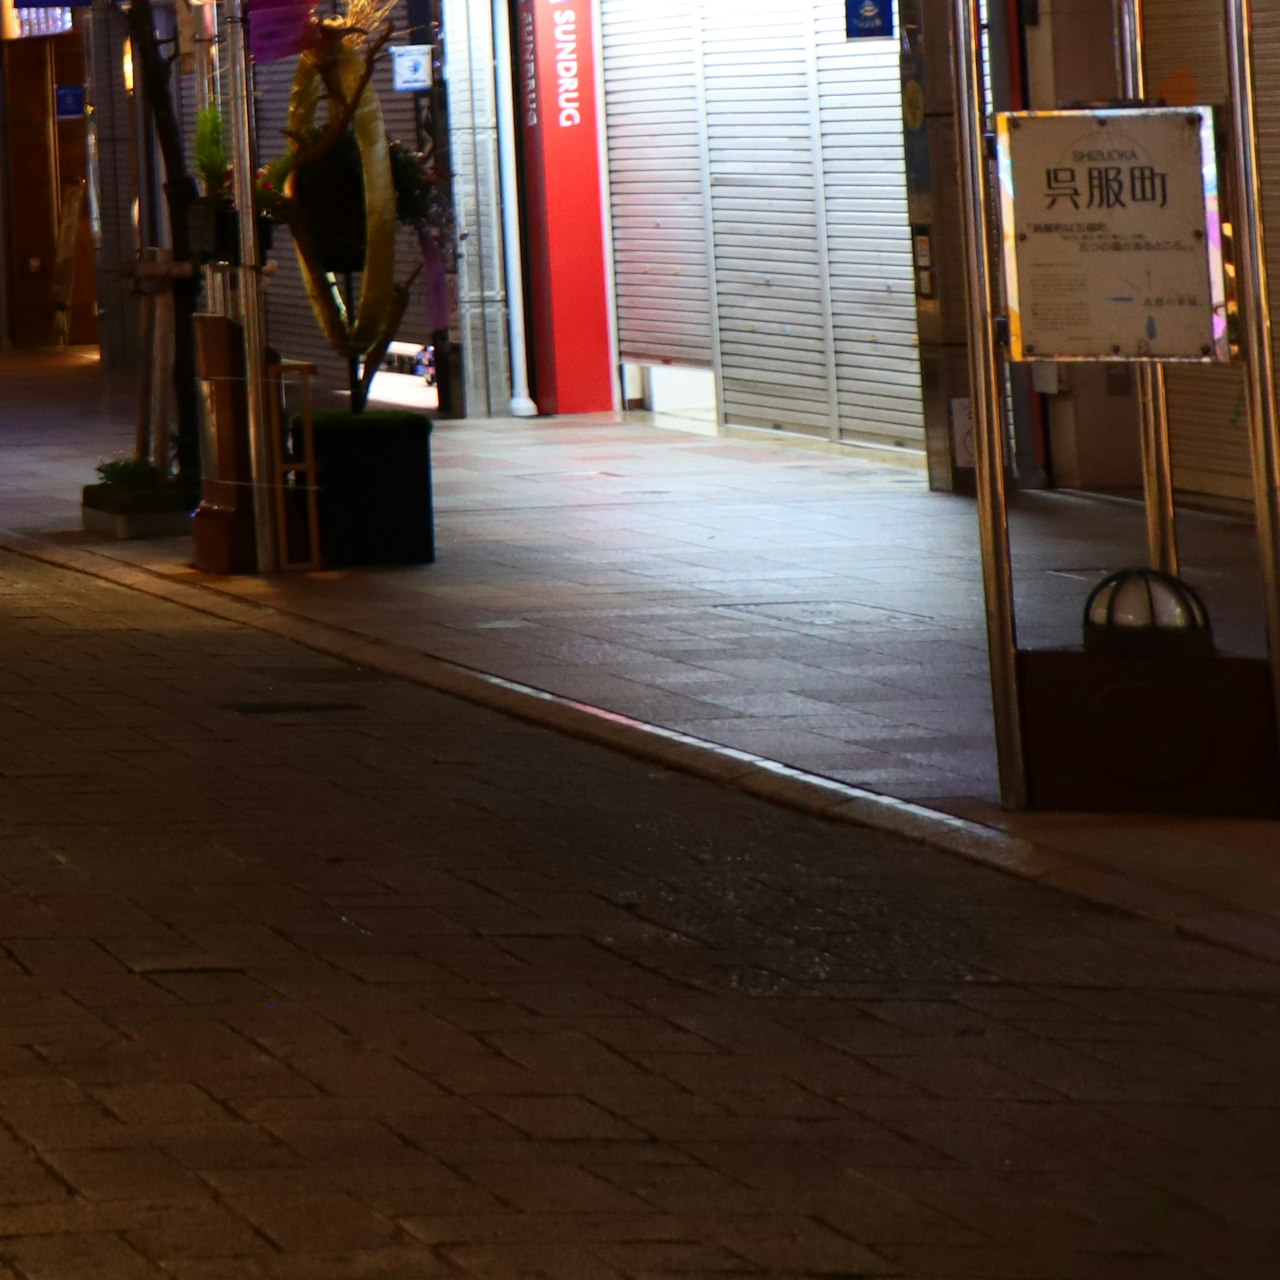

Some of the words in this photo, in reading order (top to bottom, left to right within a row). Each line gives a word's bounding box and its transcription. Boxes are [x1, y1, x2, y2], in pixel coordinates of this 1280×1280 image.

[553, 9, 581, 127] SUNDRUG
[1072, 149, 1139, 162] SHIZUOKA
[1044, 166, 1169, 210] 呉服町
